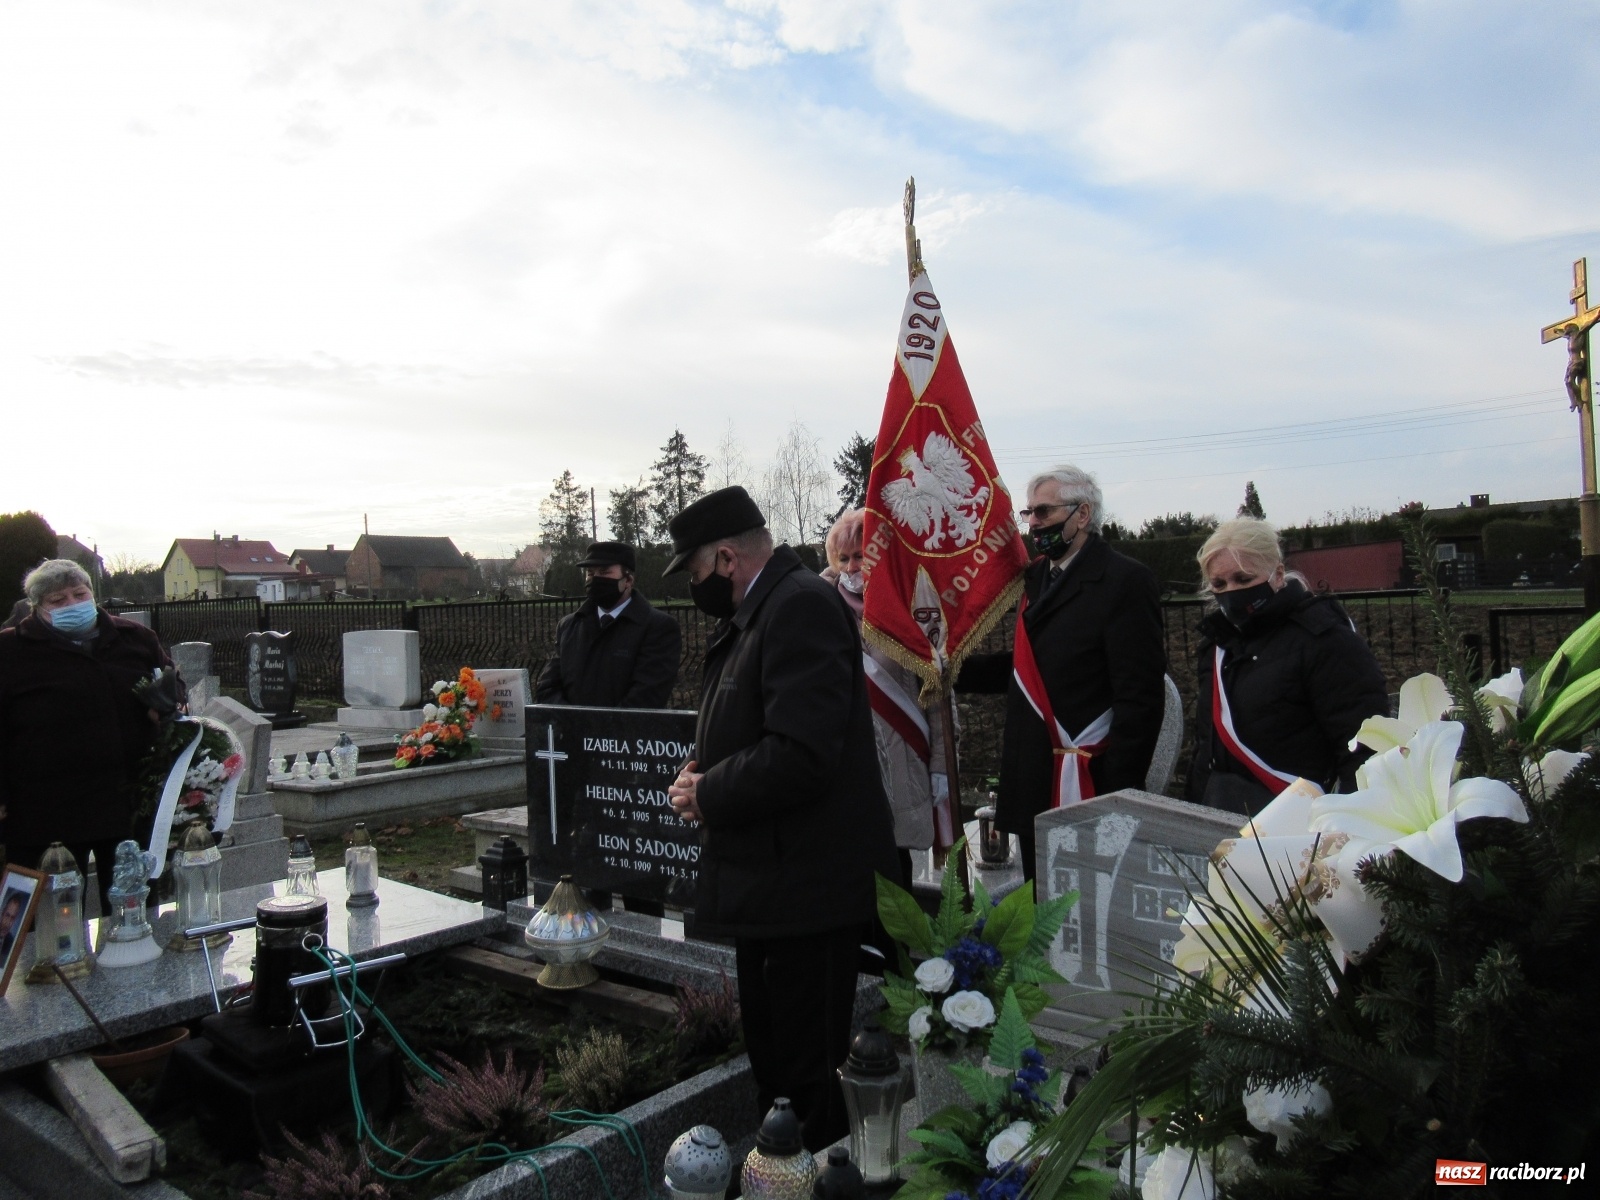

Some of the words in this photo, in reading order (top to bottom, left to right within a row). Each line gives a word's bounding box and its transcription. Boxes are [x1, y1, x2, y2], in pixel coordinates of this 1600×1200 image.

[903, 291, 941, 362] 1920
[863, 522, 894, 594] MPER
[493, 689, 512, 697] JERZY
[583, 737, 630, 754] IZABELA
[630, 762, 648, 773] 1942
[586, 784, 633, 803] HELENA
[632, 811, 650, 822] 1905
[598, 833, 630, 852] LEON
[633, 860, 652, 872] 1909
